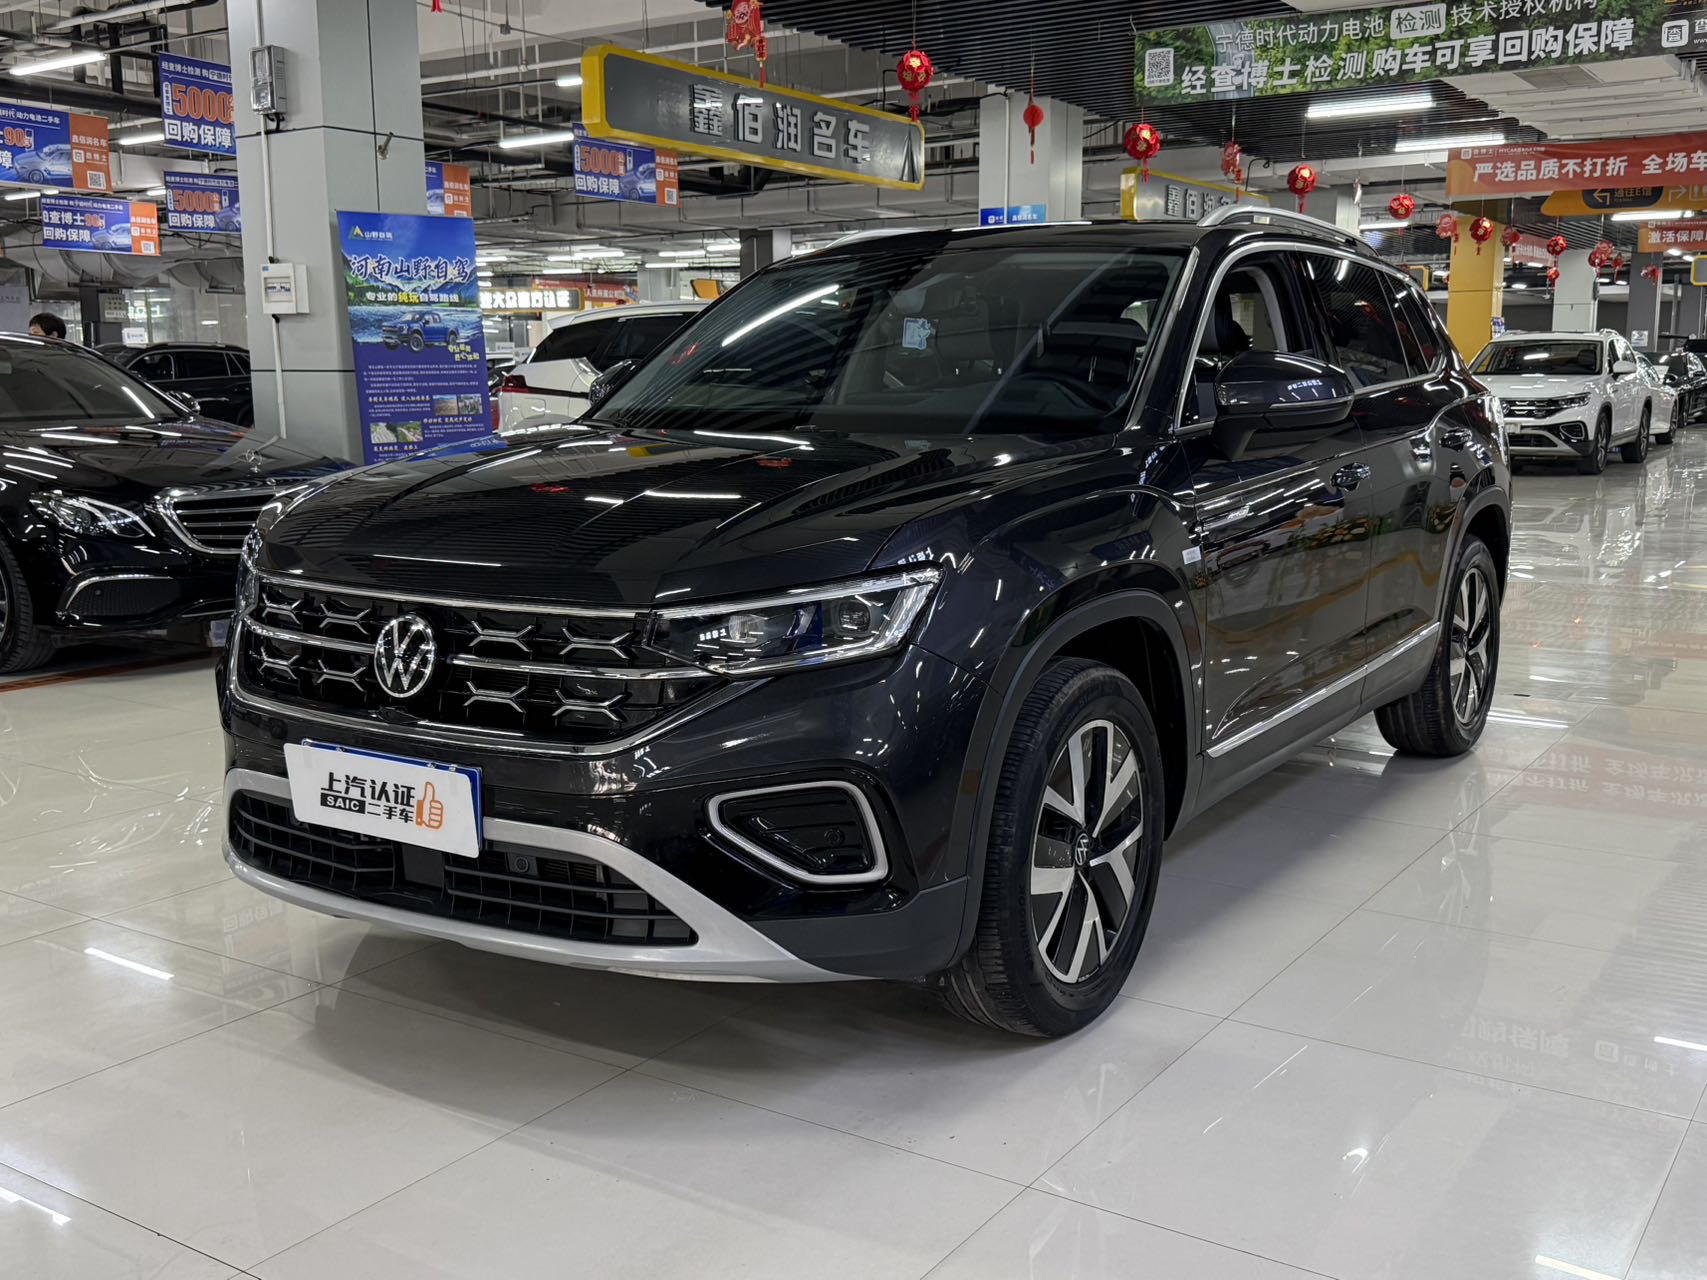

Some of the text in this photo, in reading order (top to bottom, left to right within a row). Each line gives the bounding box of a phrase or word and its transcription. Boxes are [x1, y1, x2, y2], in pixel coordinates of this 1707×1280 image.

[1216, 16, 1385, 52] 宁德时代动力电池
[1396, 9, 1442, 35] 检测
[1182, 17, 1636, 95] 经查博士检测购车可享回购保障
[164, 119, 232, 148] 回购保障
[689, 84, 871, 165] 鑫佰润名车
[1474, 156, 1629, 183] 严选品质不打折
[575, 174, 620, 196] 回购保障
[43, 227, 91, 242] 回购保障
[168, 213, 216, 229] 回购保障
[1648, 229, 1707, 245] 激活保障
[350, 254, 470, 283] 河南山野自驾
[321, 771, 416, 808] 上汽认证
[326, 796, 360, 811] SAIC
[366, 802, 414, 824] 二手车
